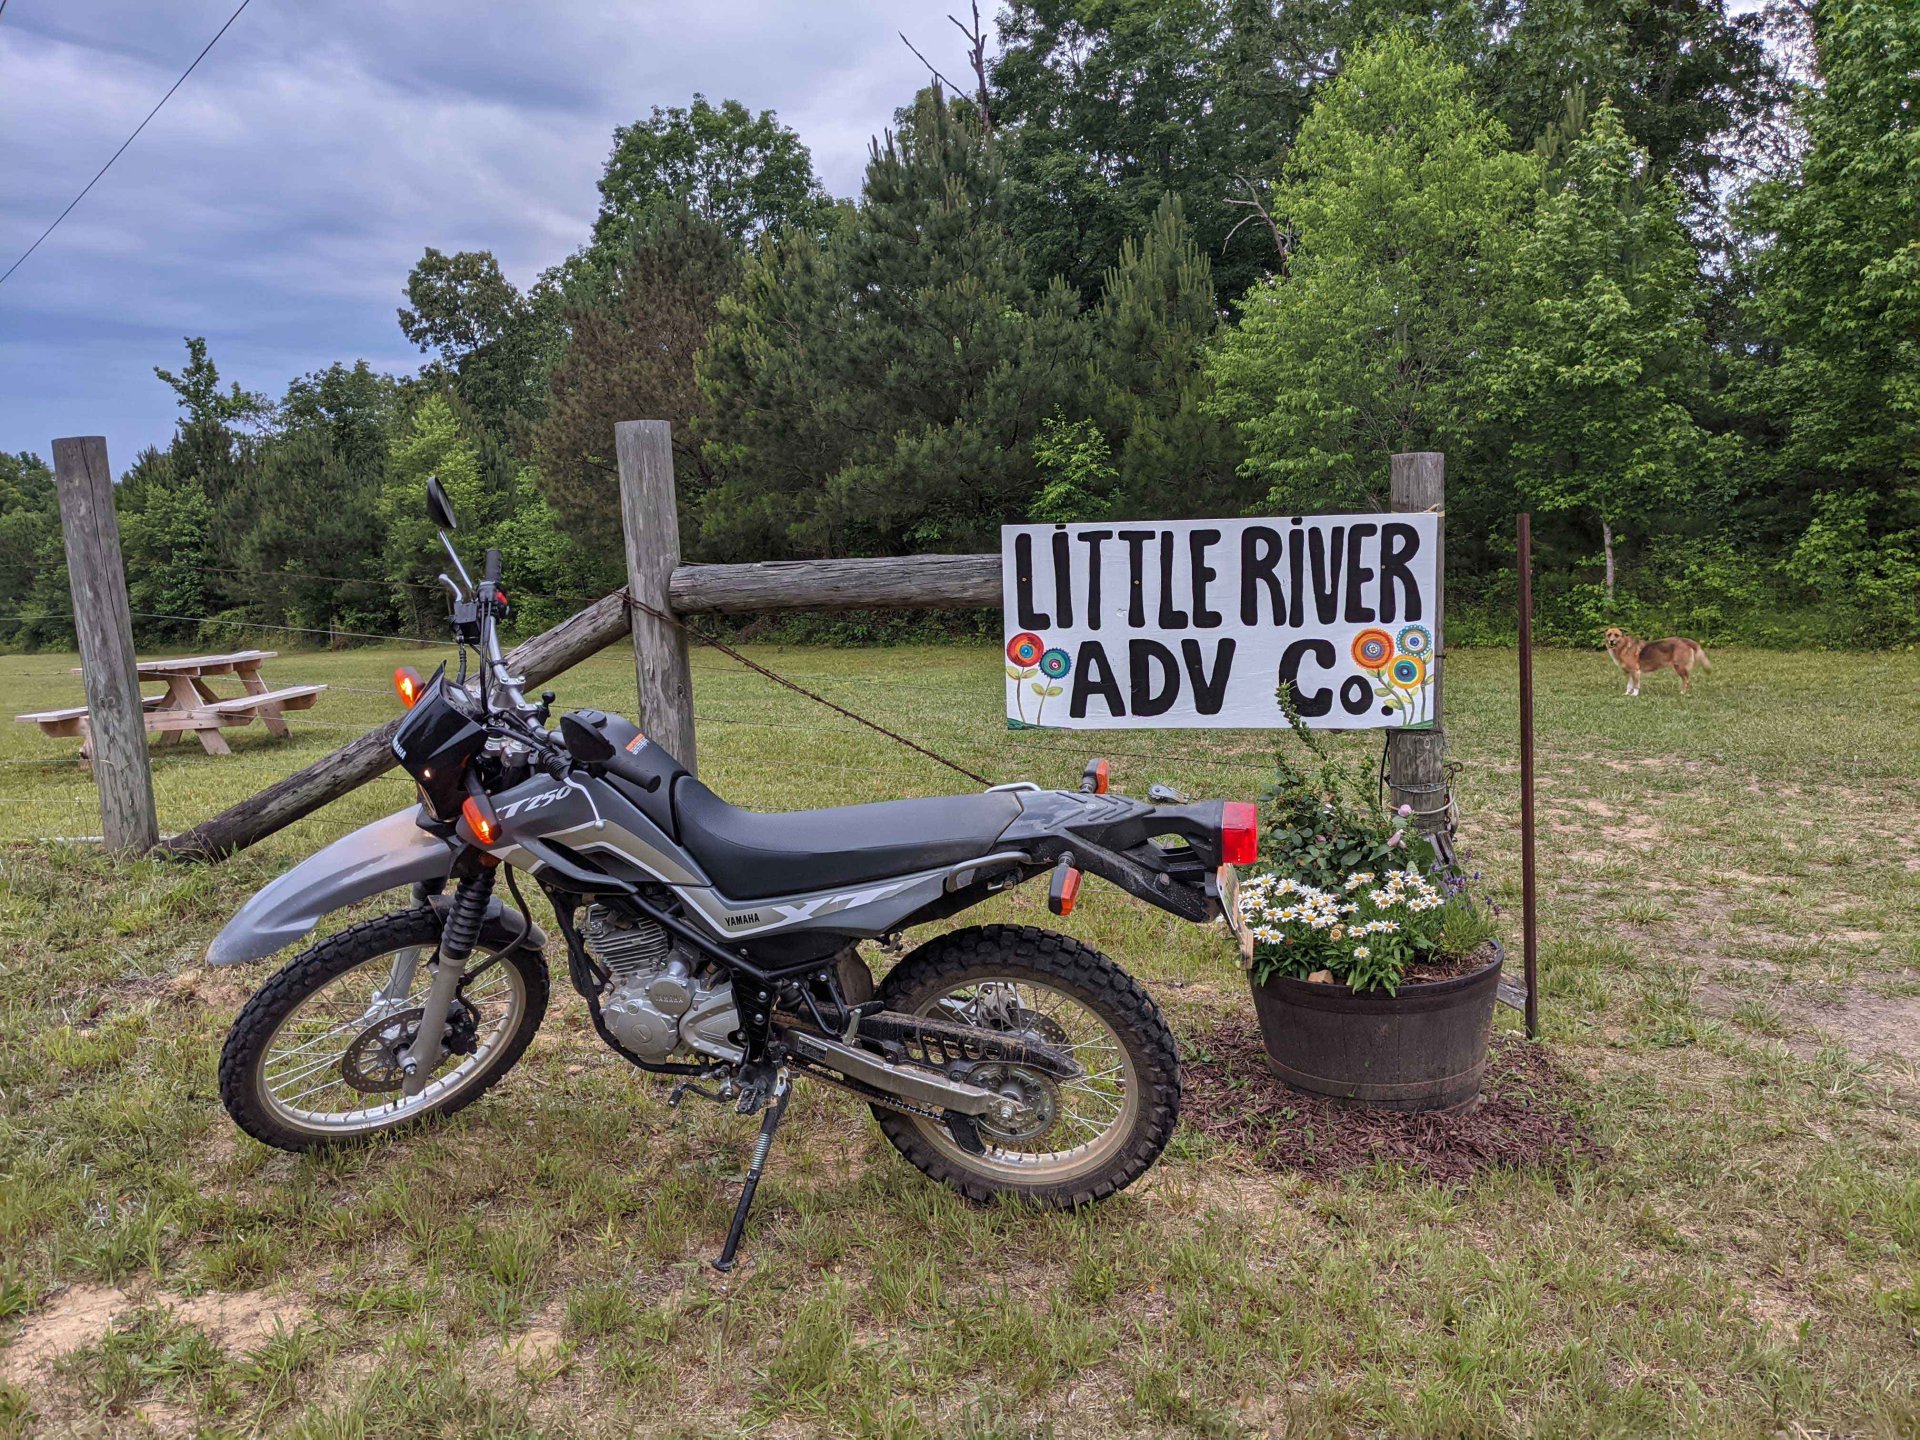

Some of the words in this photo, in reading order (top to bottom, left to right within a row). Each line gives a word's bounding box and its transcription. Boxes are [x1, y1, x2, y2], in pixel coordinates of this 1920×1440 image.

[1069, 638, 1237, 719] ADV
[495, 785, 573, 820] T250
[724, 912, 761, 927] YAMAHA
